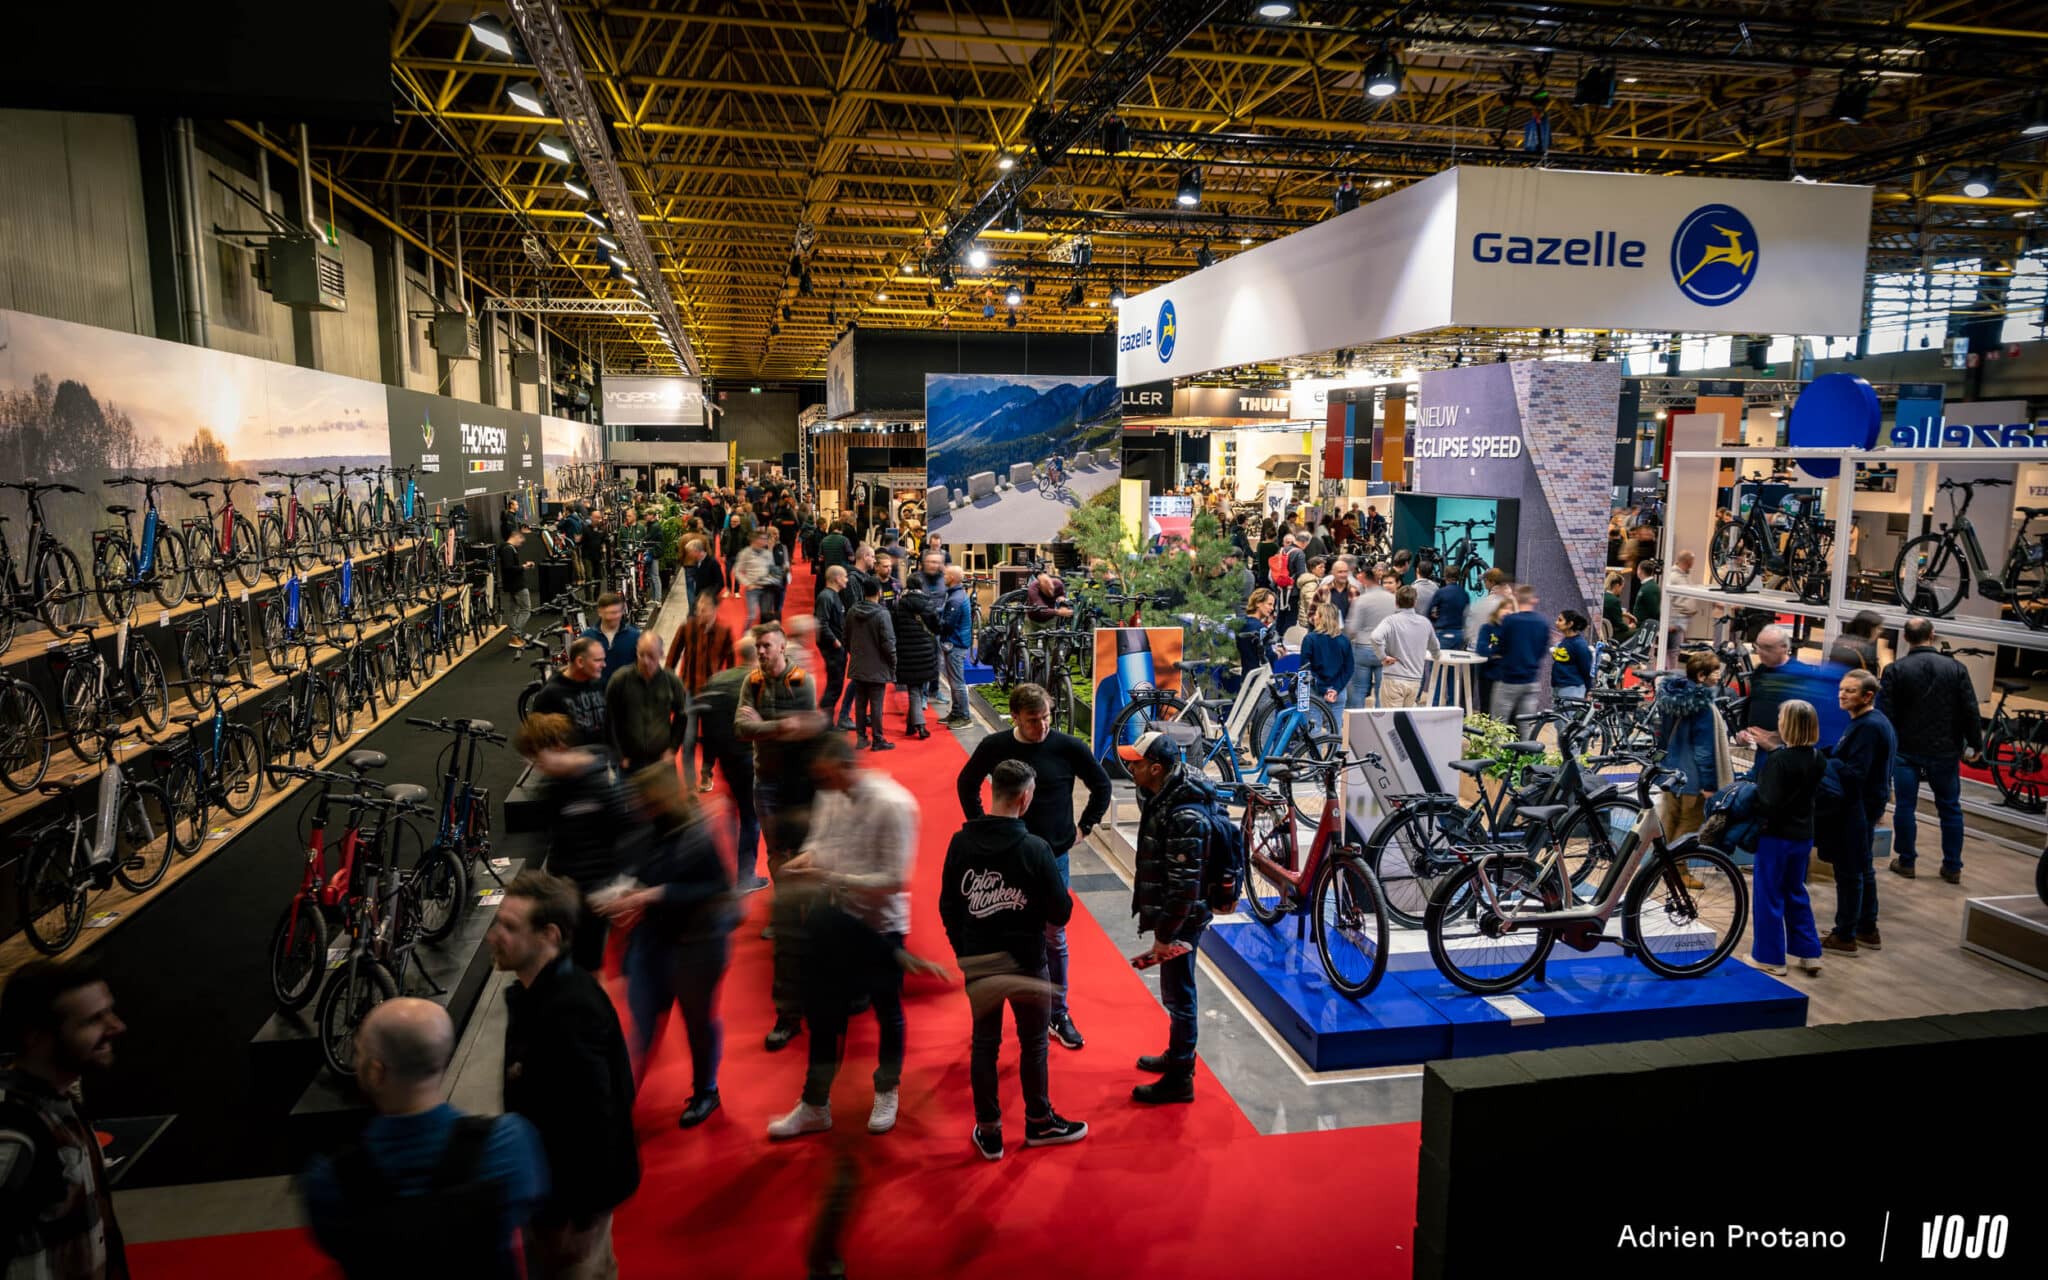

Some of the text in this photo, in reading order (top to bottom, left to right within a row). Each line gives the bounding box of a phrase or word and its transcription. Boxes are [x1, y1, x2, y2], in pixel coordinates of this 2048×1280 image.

[1472, 230, 1647, 268] Gazelle
[1120, 325, 1152, 352] Gazelle
[1239, 397, 1289, 412] THULE
[1416, 405, 1459, 428] NIEUW
[460, 423, 507, 454] THOMPSON
[1415, 434, 1521, 458] ECLIPSE SPEED
[961, 868, 1002, 896] Color
